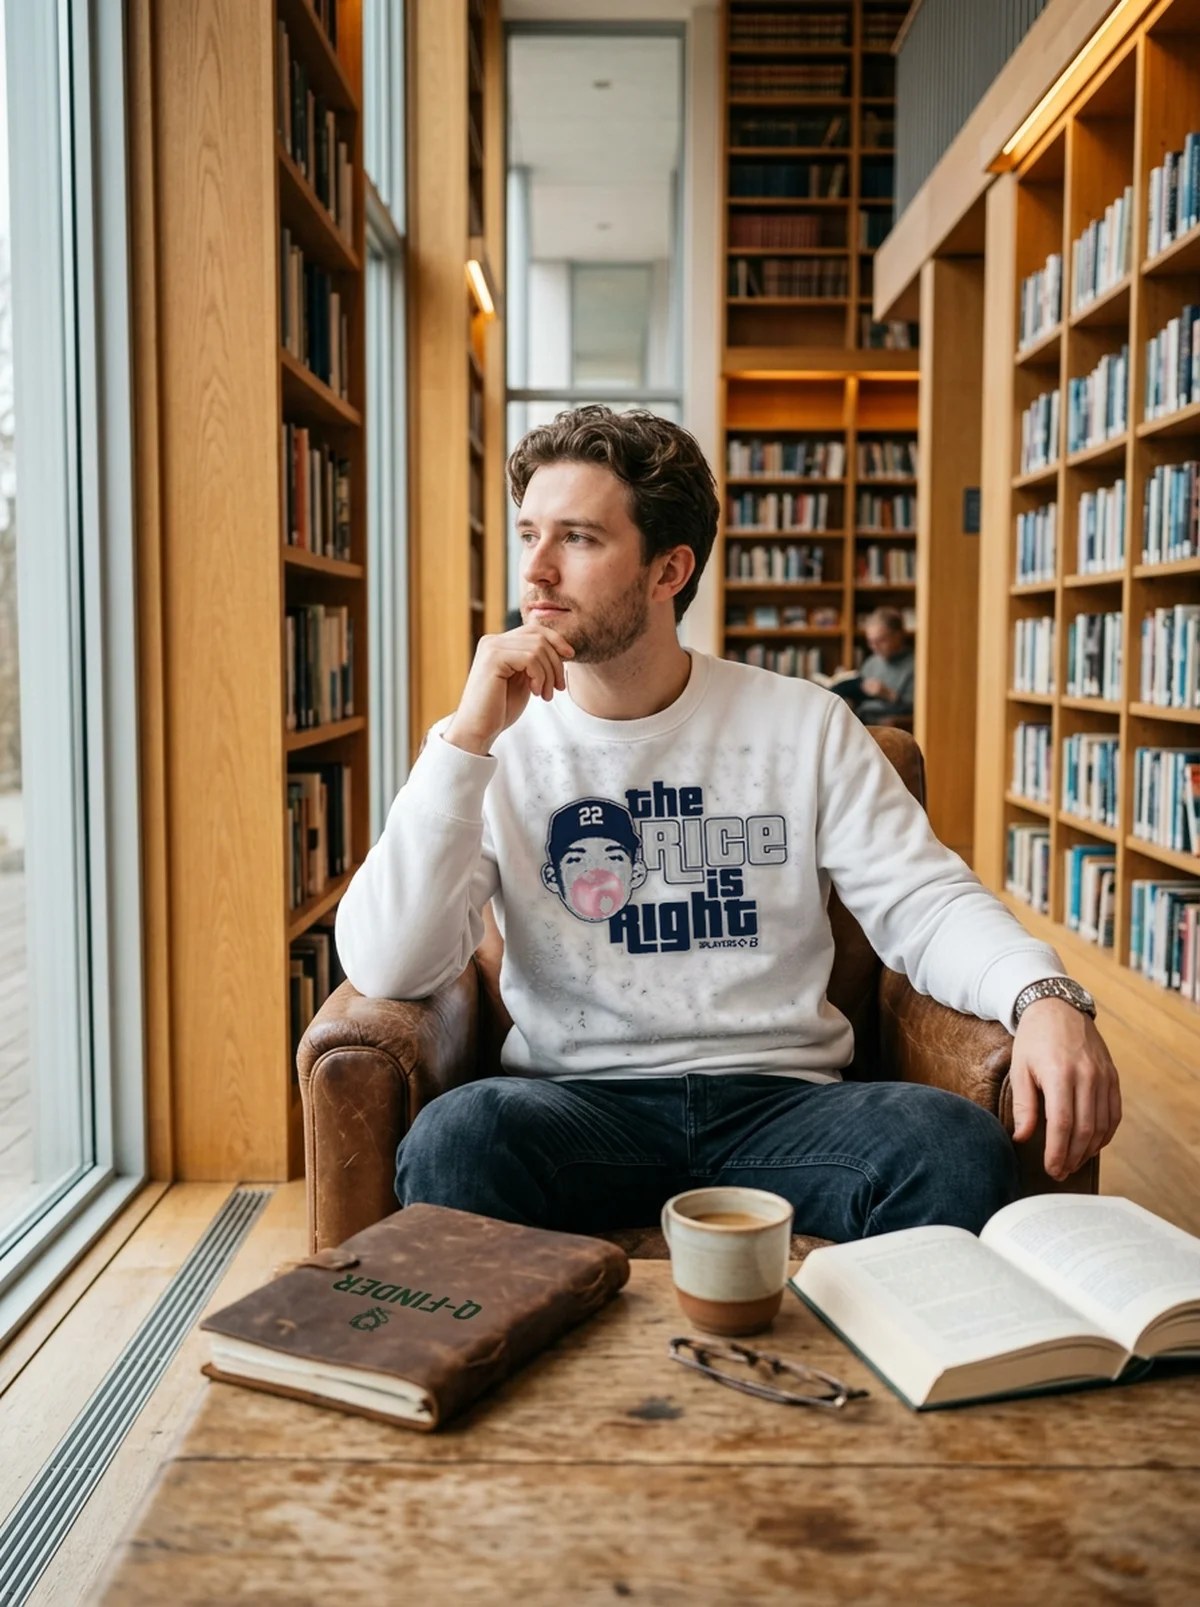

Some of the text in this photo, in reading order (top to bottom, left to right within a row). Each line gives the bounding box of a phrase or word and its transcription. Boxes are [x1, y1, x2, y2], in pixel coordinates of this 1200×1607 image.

[578, 806, 604, 826] 22
[625, 781, 703, 818] the
[707, 868, 743, 898] is
[333, 1274, 482, 1320] Q-FINDER
